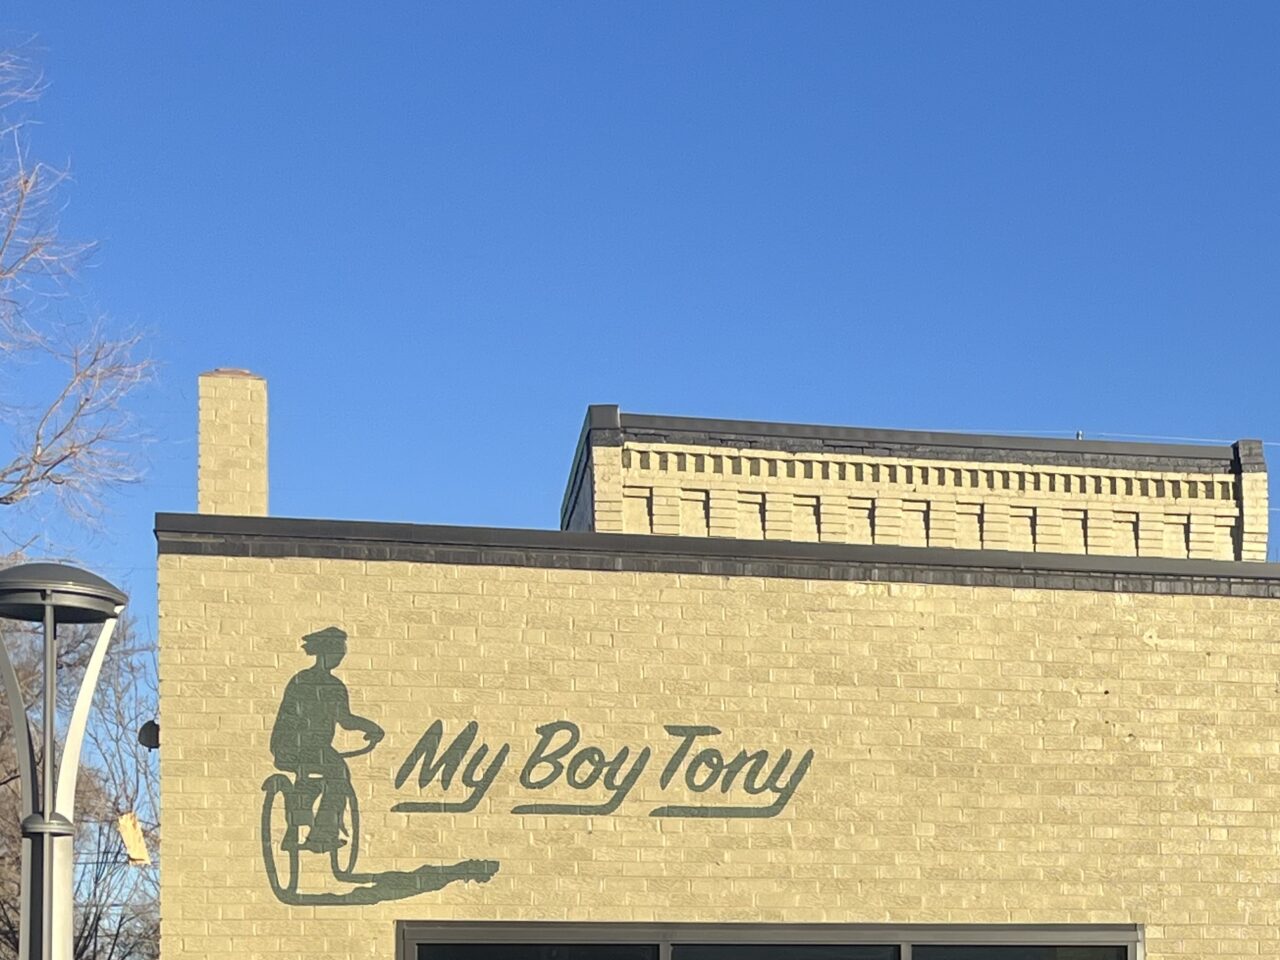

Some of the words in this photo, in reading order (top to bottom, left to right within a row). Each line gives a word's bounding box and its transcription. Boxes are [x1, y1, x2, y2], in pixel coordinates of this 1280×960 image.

[390, 719, 510, 813] My
[511, 720, 651, 816] Boy
[649, 724, 814, 819] Tony
